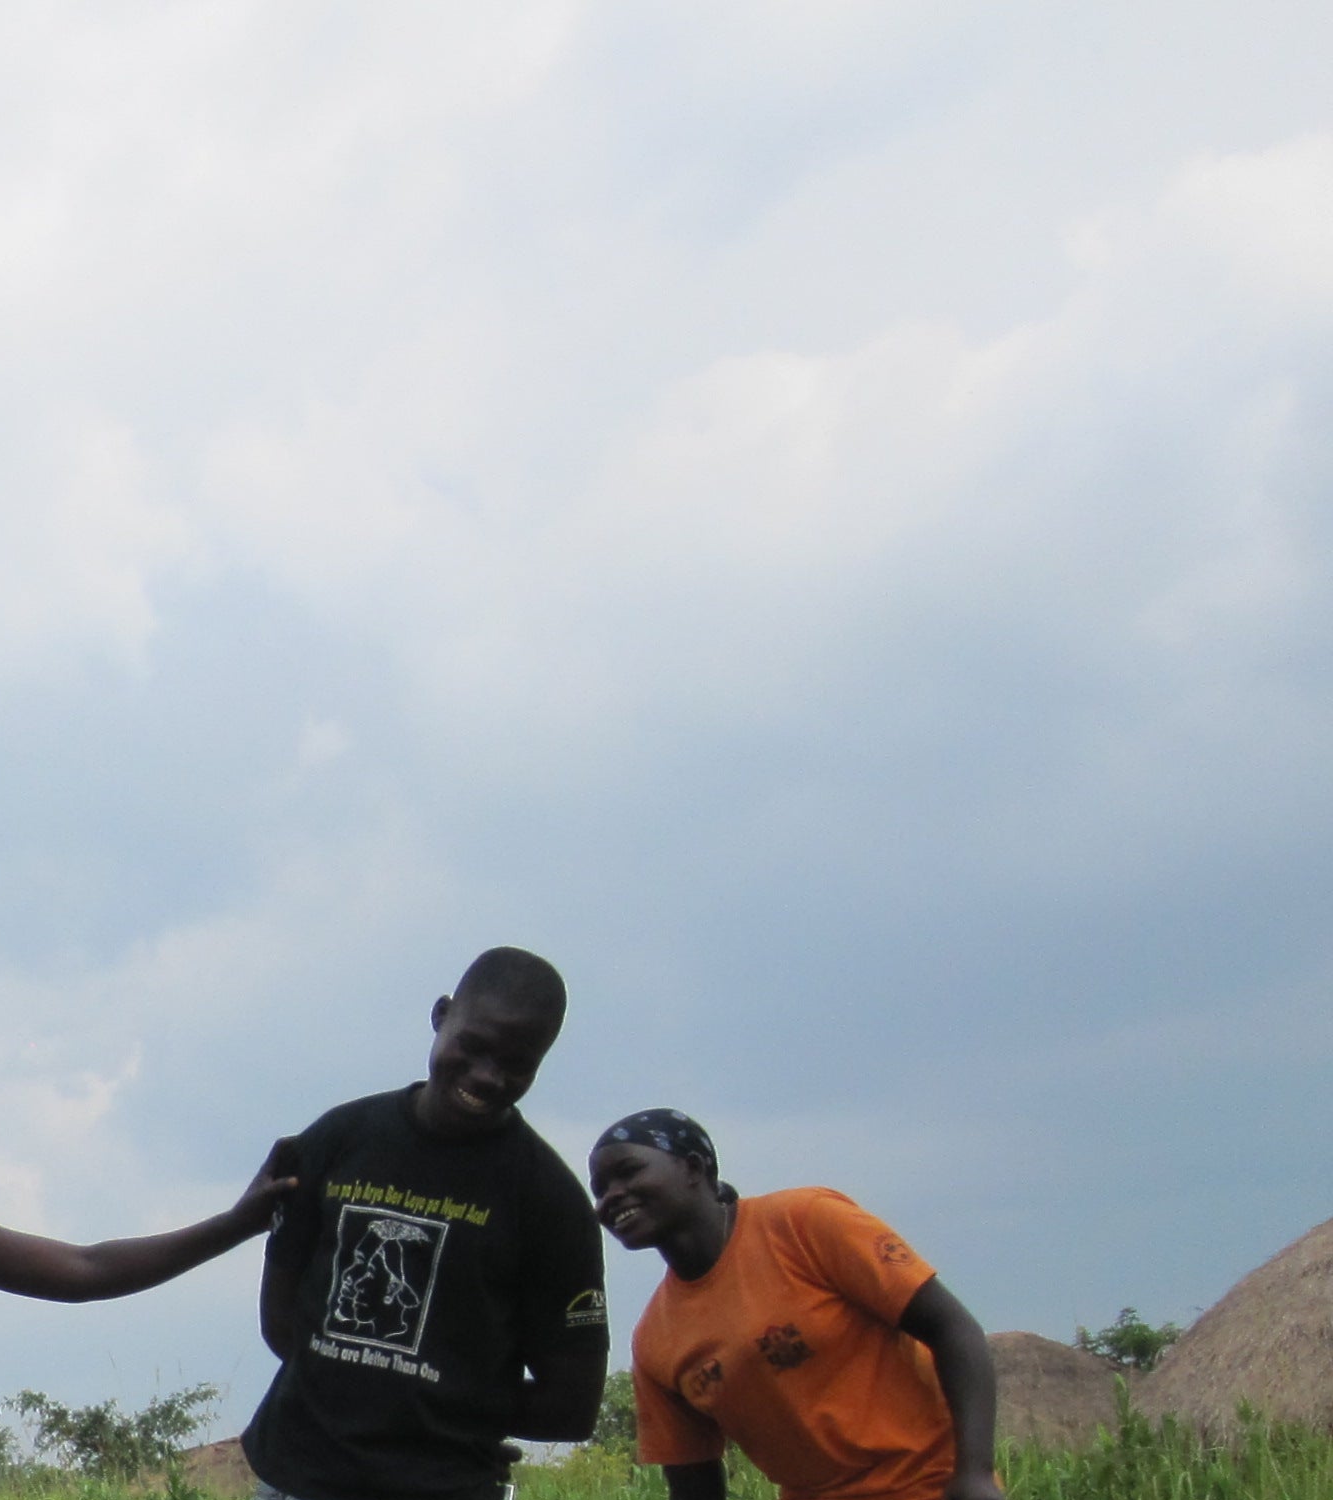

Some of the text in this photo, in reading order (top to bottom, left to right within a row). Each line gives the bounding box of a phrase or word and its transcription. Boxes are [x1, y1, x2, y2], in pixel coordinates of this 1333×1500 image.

[341, 1348, 359, 1362] are
[362, 1347, 390, 1368] Better
[393, 1354, 417, 1375] Than
[420, 1362, 440, 1382] One
